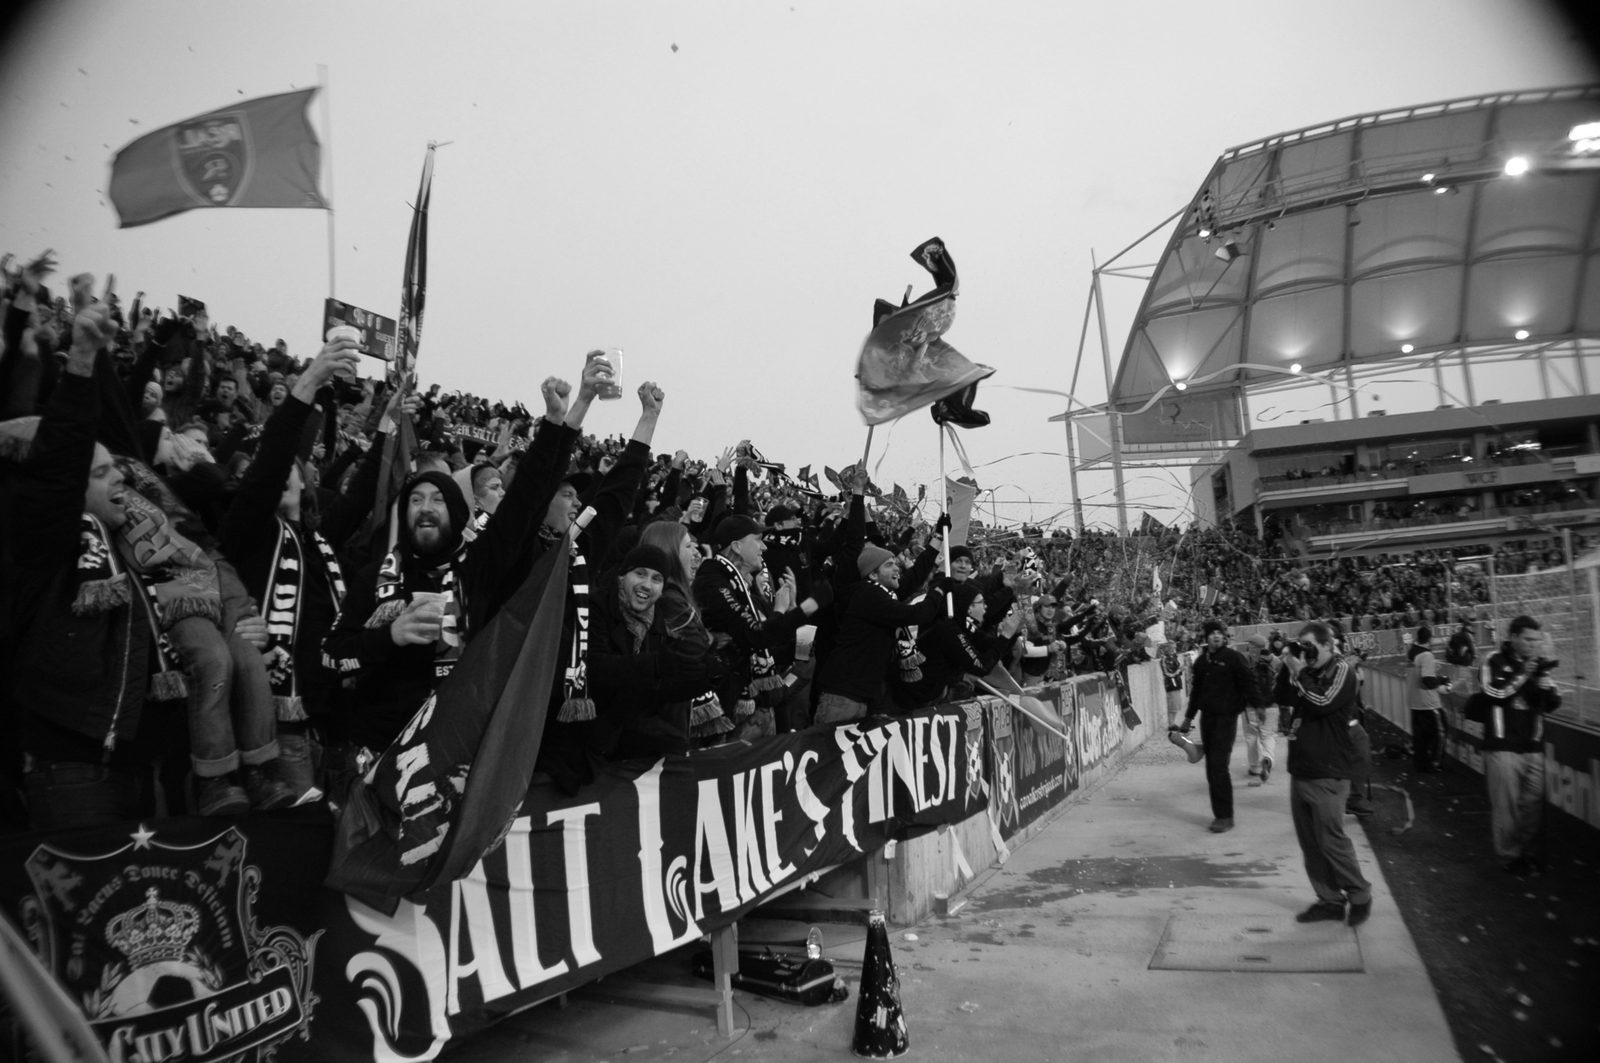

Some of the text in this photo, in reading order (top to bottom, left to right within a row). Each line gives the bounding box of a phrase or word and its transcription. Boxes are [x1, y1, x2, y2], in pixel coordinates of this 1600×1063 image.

[1466, 471, 1498, 484] WCF
[345, 714, 960, 1063] SALT LAKE'S FINEST
[186, 987, 291, 1055] UNITED
